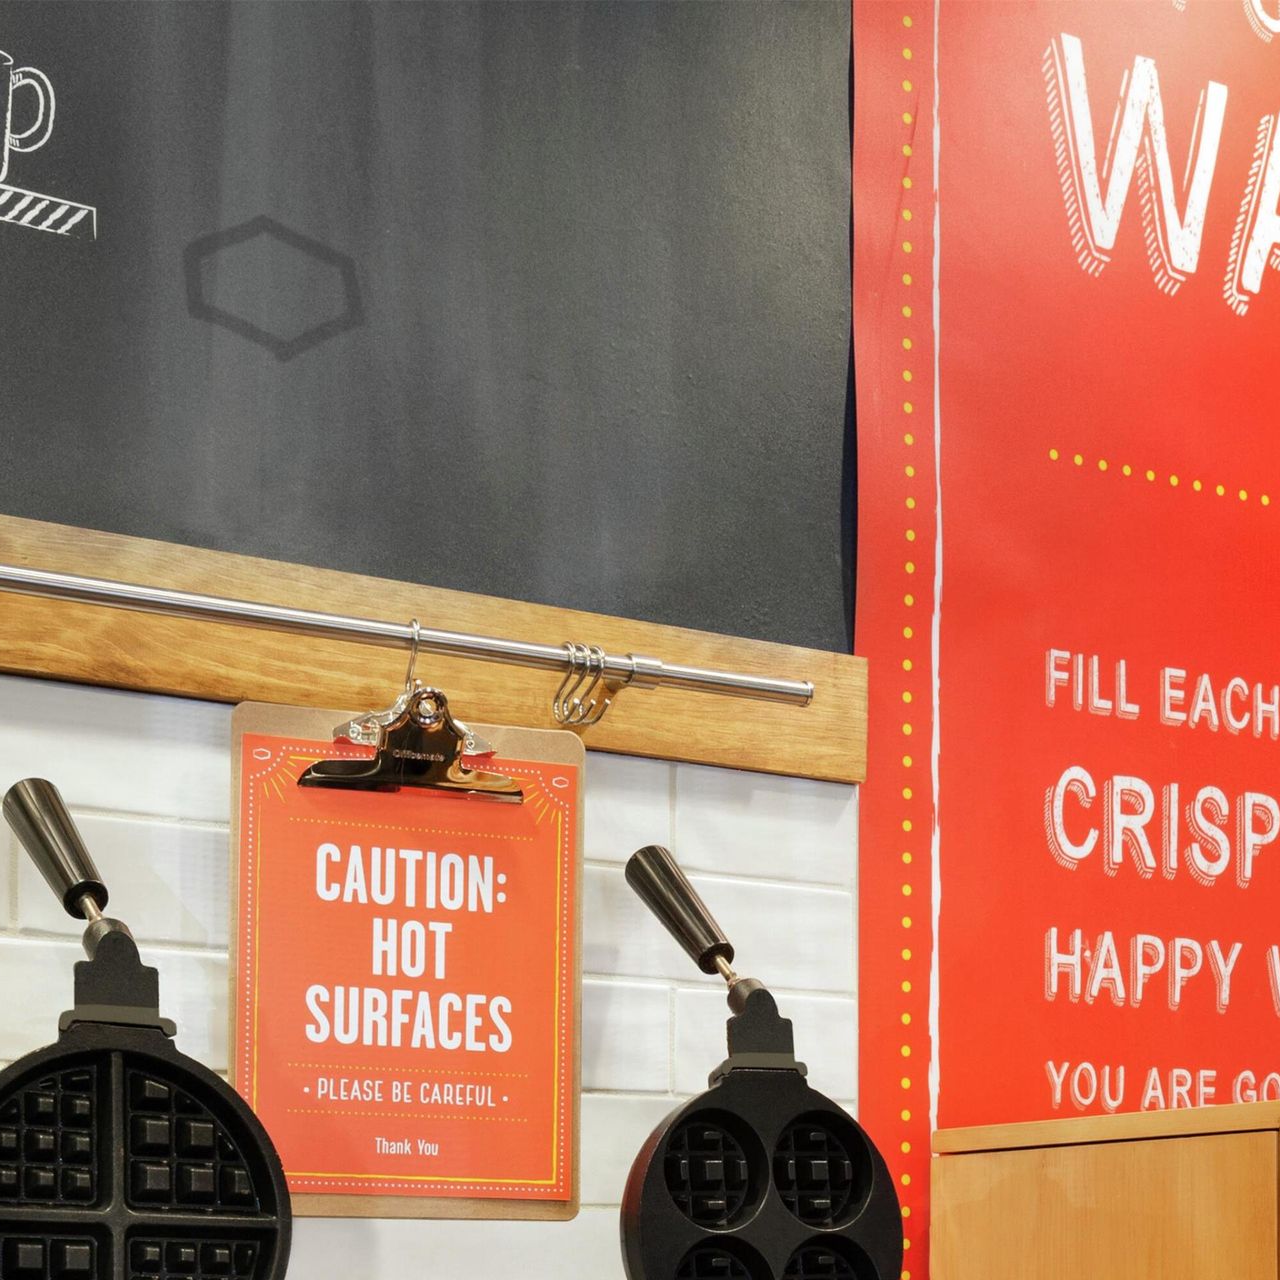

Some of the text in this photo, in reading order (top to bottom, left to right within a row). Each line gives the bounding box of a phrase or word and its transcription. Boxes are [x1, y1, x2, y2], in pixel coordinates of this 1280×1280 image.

[1044, 648, 1141, 719] FILL
[1159, 667, 1280, 738] EACH
[315, 843, 507, 914] CAUTION:
[371, 918, 453, 979] HOT
[1043, 926, 1243, 1014] HAPPY
[304, 985, 514, 1054] SURFACES
[316, 1077, 497, 1107] PLEASE BE CAREFUL
[1045, 1061, 1125, 1113] YOU
[1139, 1067, 1217, 1112] ARE
[374, 1136, 439, 1157] Thank You
